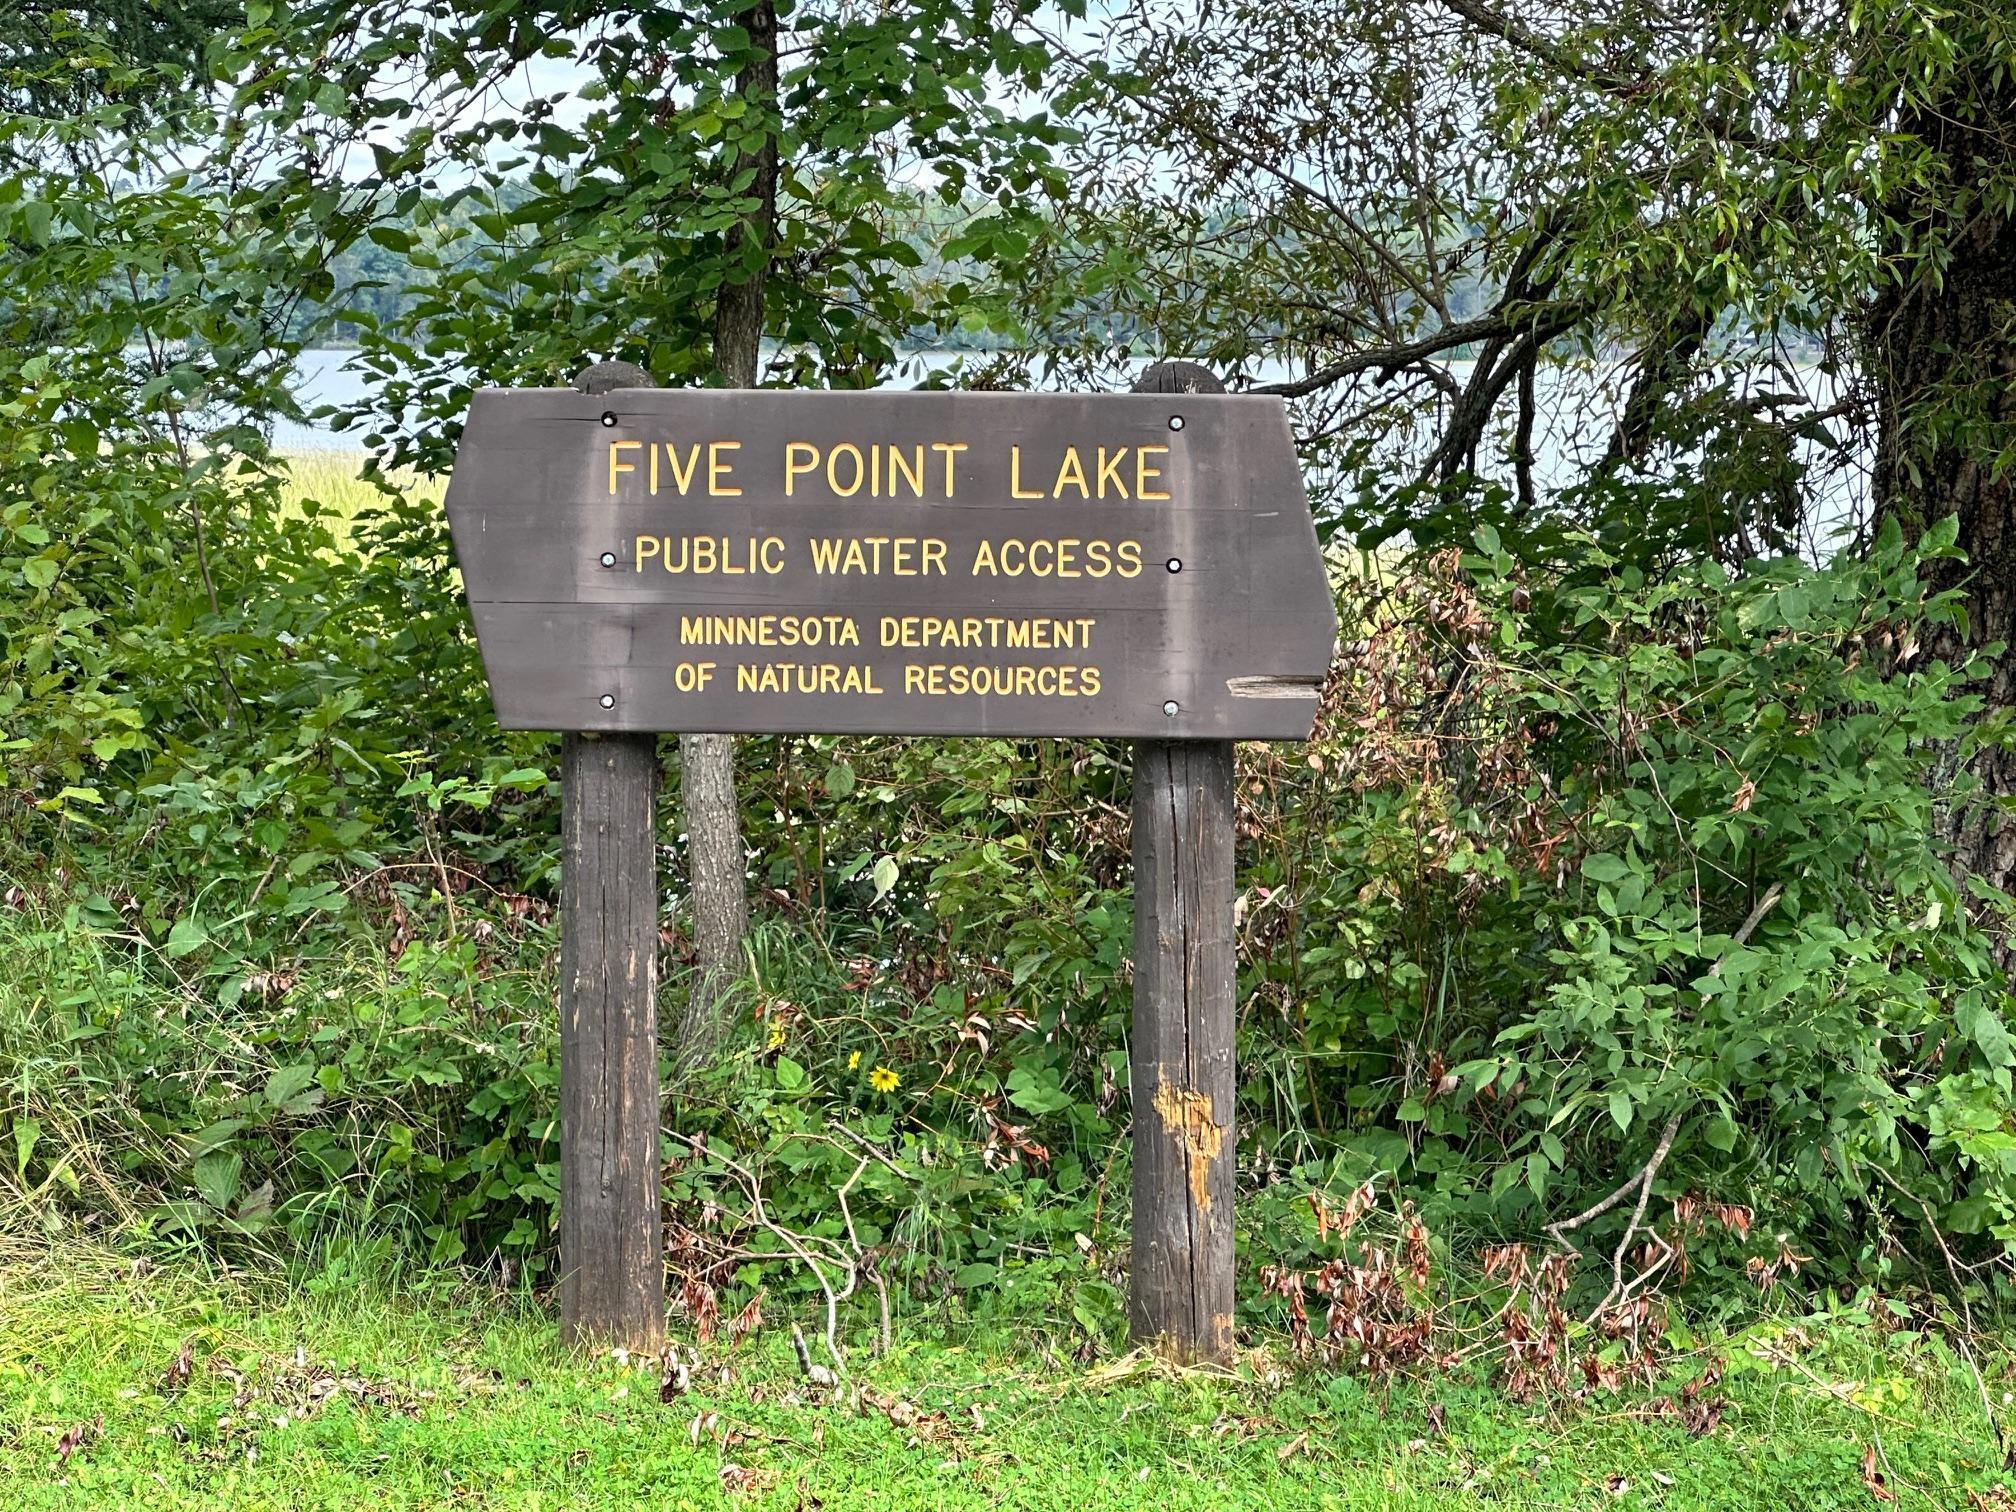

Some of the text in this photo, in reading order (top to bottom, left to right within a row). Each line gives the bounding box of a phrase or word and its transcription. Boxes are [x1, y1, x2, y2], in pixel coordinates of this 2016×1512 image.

[609, 441, 1170, 500] FIVE POINT LAKE
[636, 535, 1143, 577] PUBLIC WATER ACCESS
[681, 615, 1096, 649] MINNESOTA DEPARTMENT
[675, 662, 1101, 696] OF NATURAL RESOURCES
